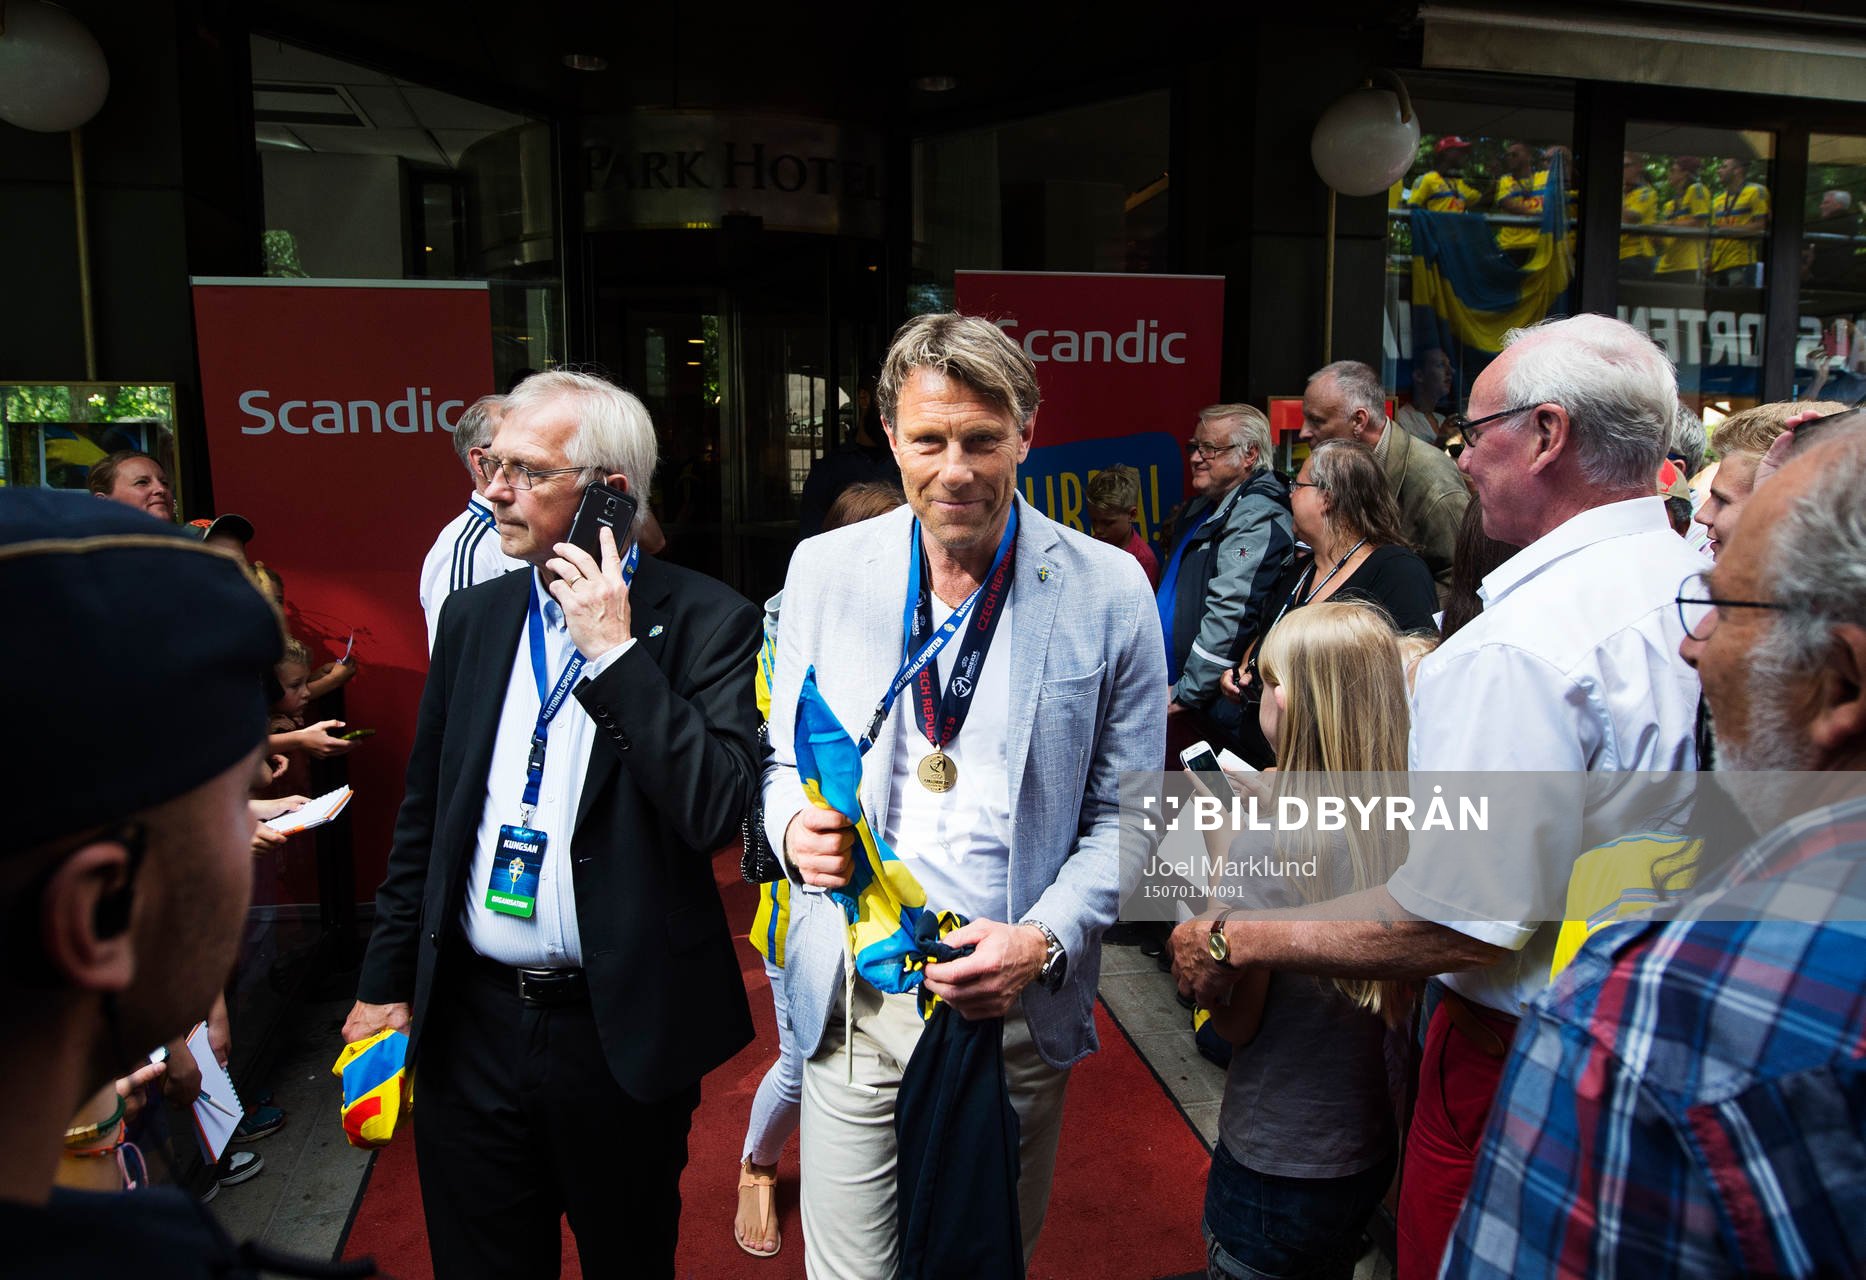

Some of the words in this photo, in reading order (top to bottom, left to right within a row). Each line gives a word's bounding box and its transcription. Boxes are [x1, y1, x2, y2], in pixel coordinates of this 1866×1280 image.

[583, 146, 710, 192] PARK
[238, 386, 465, 435] Scandic
[976, 592, 998, 631] CZECH
[894, 636, 945, 692] NATIONALSPORTEN
[919, 665, 932, 695] ECH
[542, 657, 582, 720] NATIONALSPORTEN
[503, 839, 539, 854] KUNGSAN
